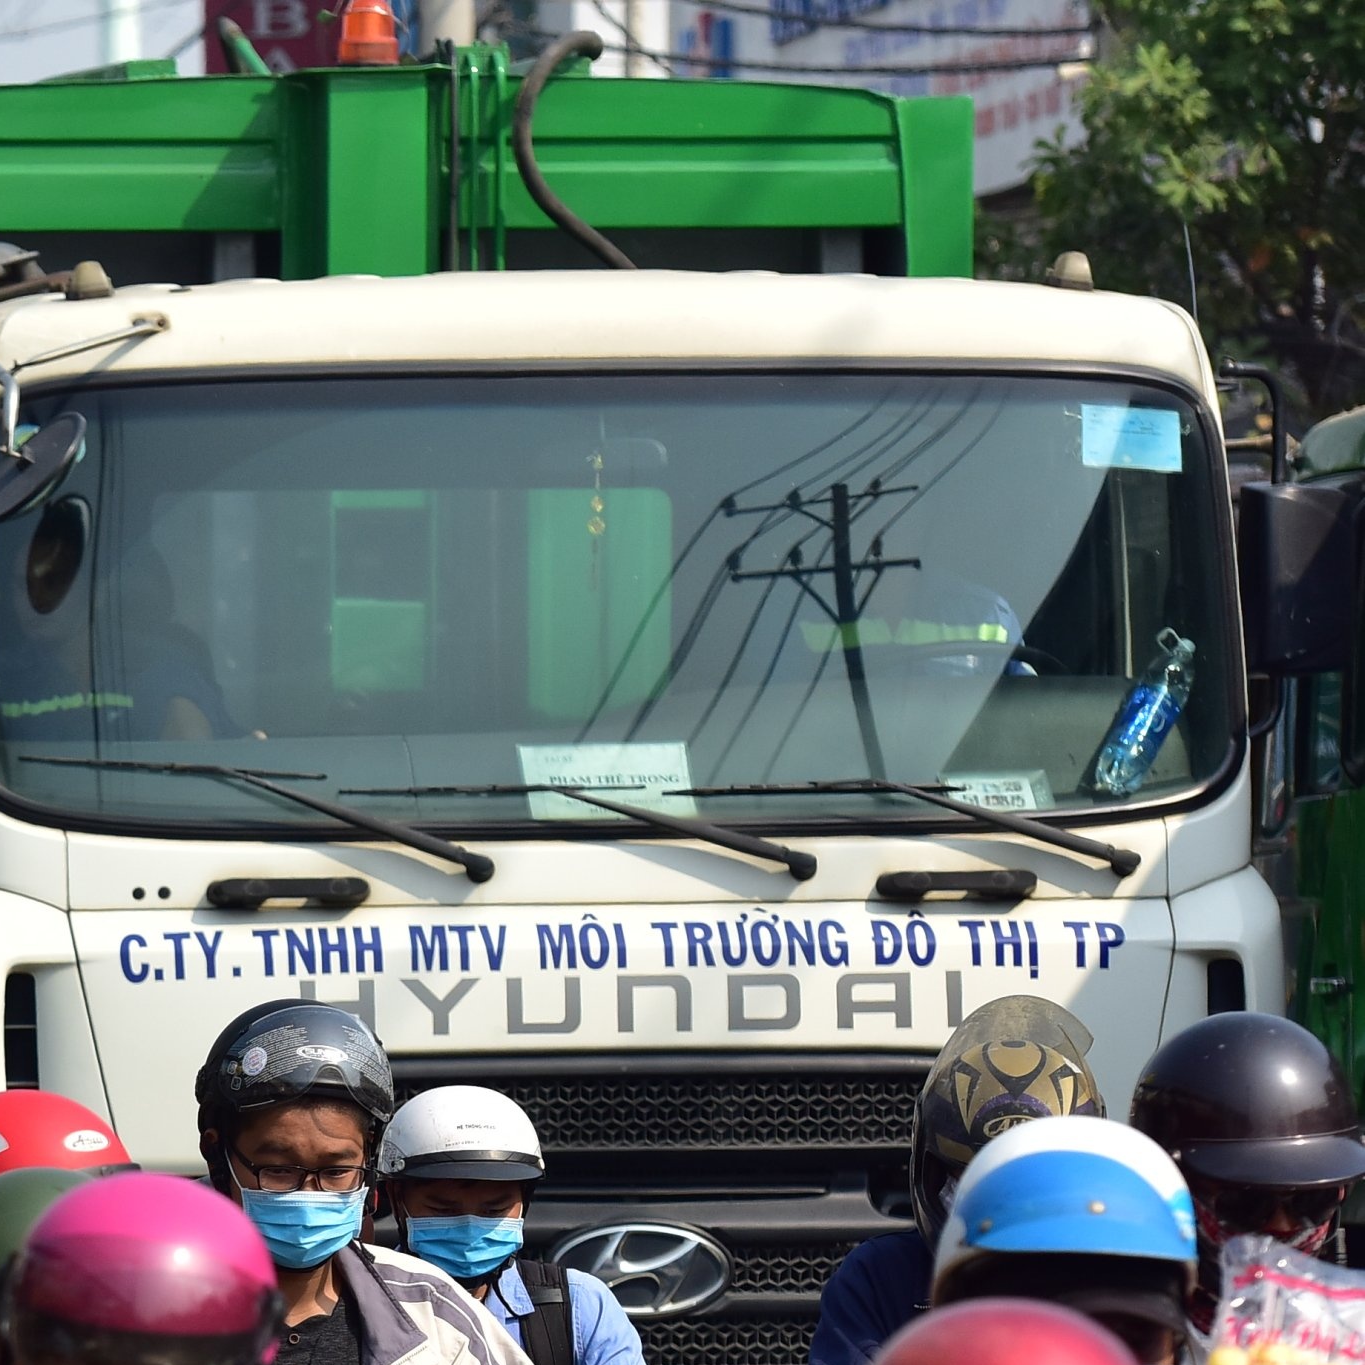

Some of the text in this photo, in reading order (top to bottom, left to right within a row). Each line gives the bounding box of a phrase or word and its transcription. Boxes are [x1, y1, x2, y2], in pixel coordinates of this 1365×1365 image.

[252, 926, 384, 978] TNHH
[409, 923, 507, 972] MTV
[538, 912, 628, 970] MÔI
[650, 907, 850, 969] TRƯỜNG
[870, 909, 937, 968] ĐÔ
[959, 919, 1040, 979] THỊ
[1063, 920, 1126, 970] TP
[299, 970, 964, 1033] HYUNDAI
